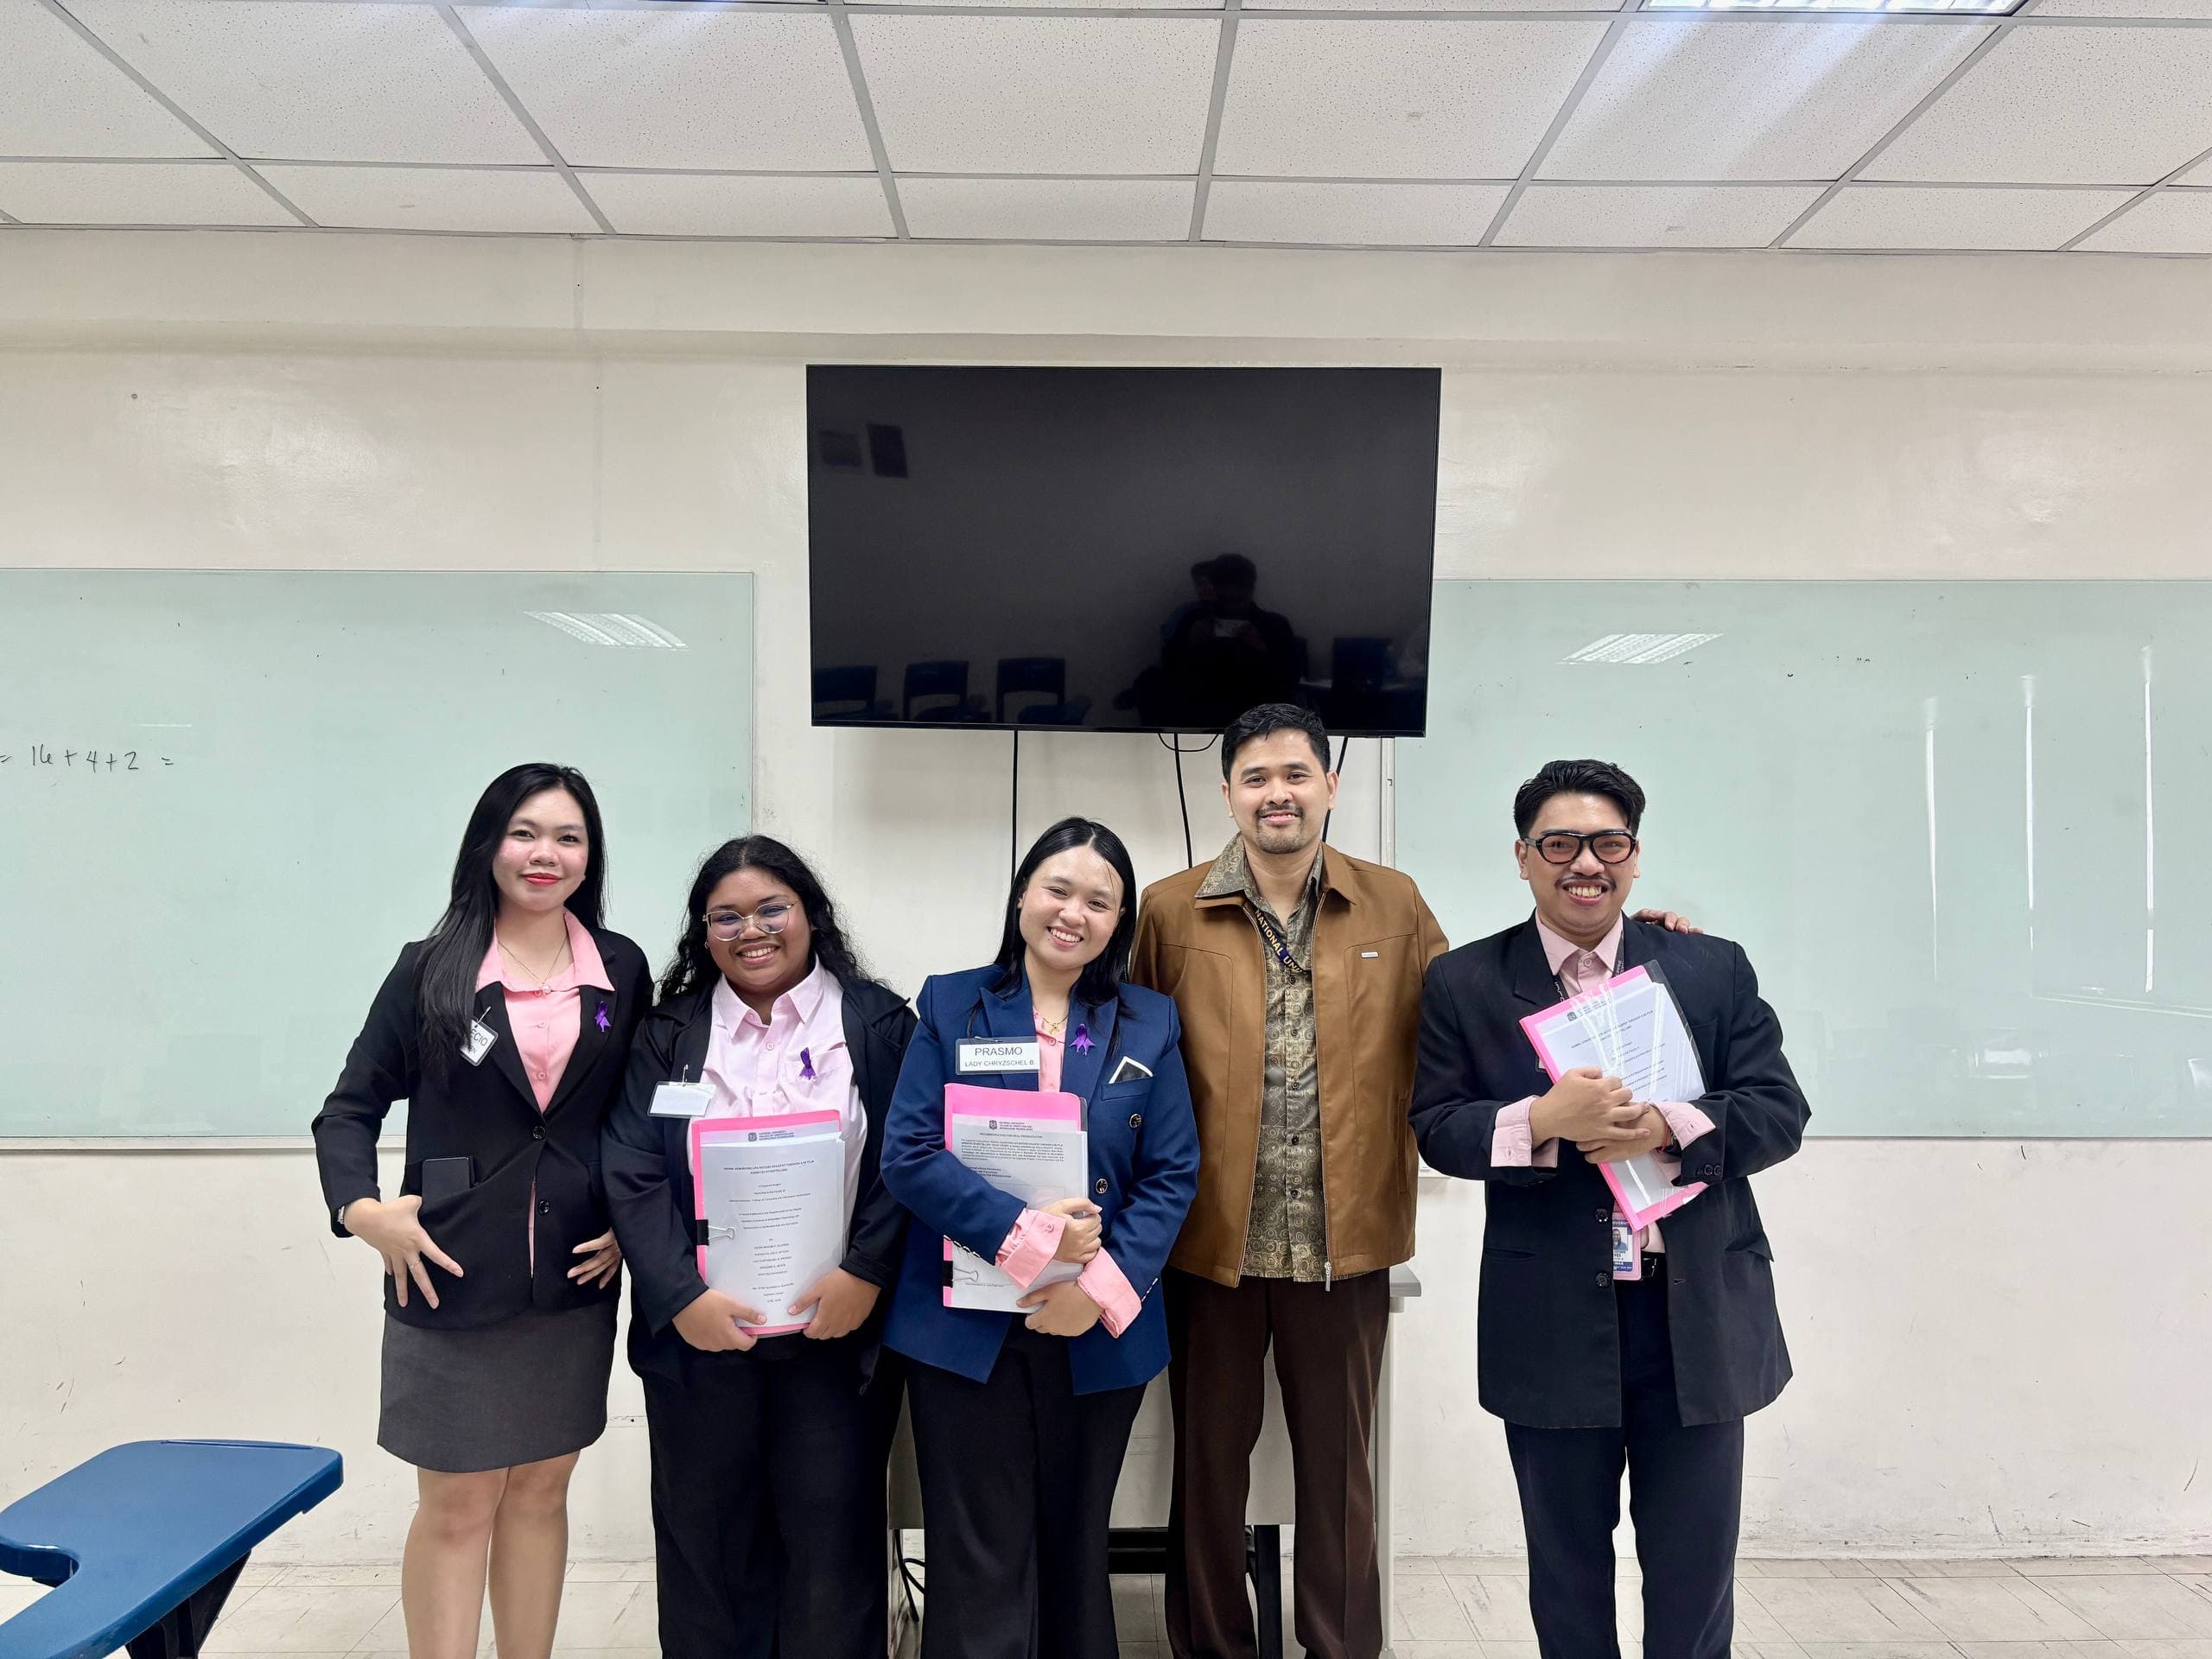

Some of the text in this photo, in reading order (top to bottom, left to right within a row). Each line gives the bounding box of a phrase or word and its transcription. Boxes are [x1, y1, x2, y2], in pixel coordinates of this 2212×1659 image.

[32, 744, 54, 766] 16
[86, 750, 98, 773] 4
[124, 751, 139, 771] 2
[1255, 909, 1284, 957] NATIONAL
[975, 1046, 1023, 1057] PRASMO
